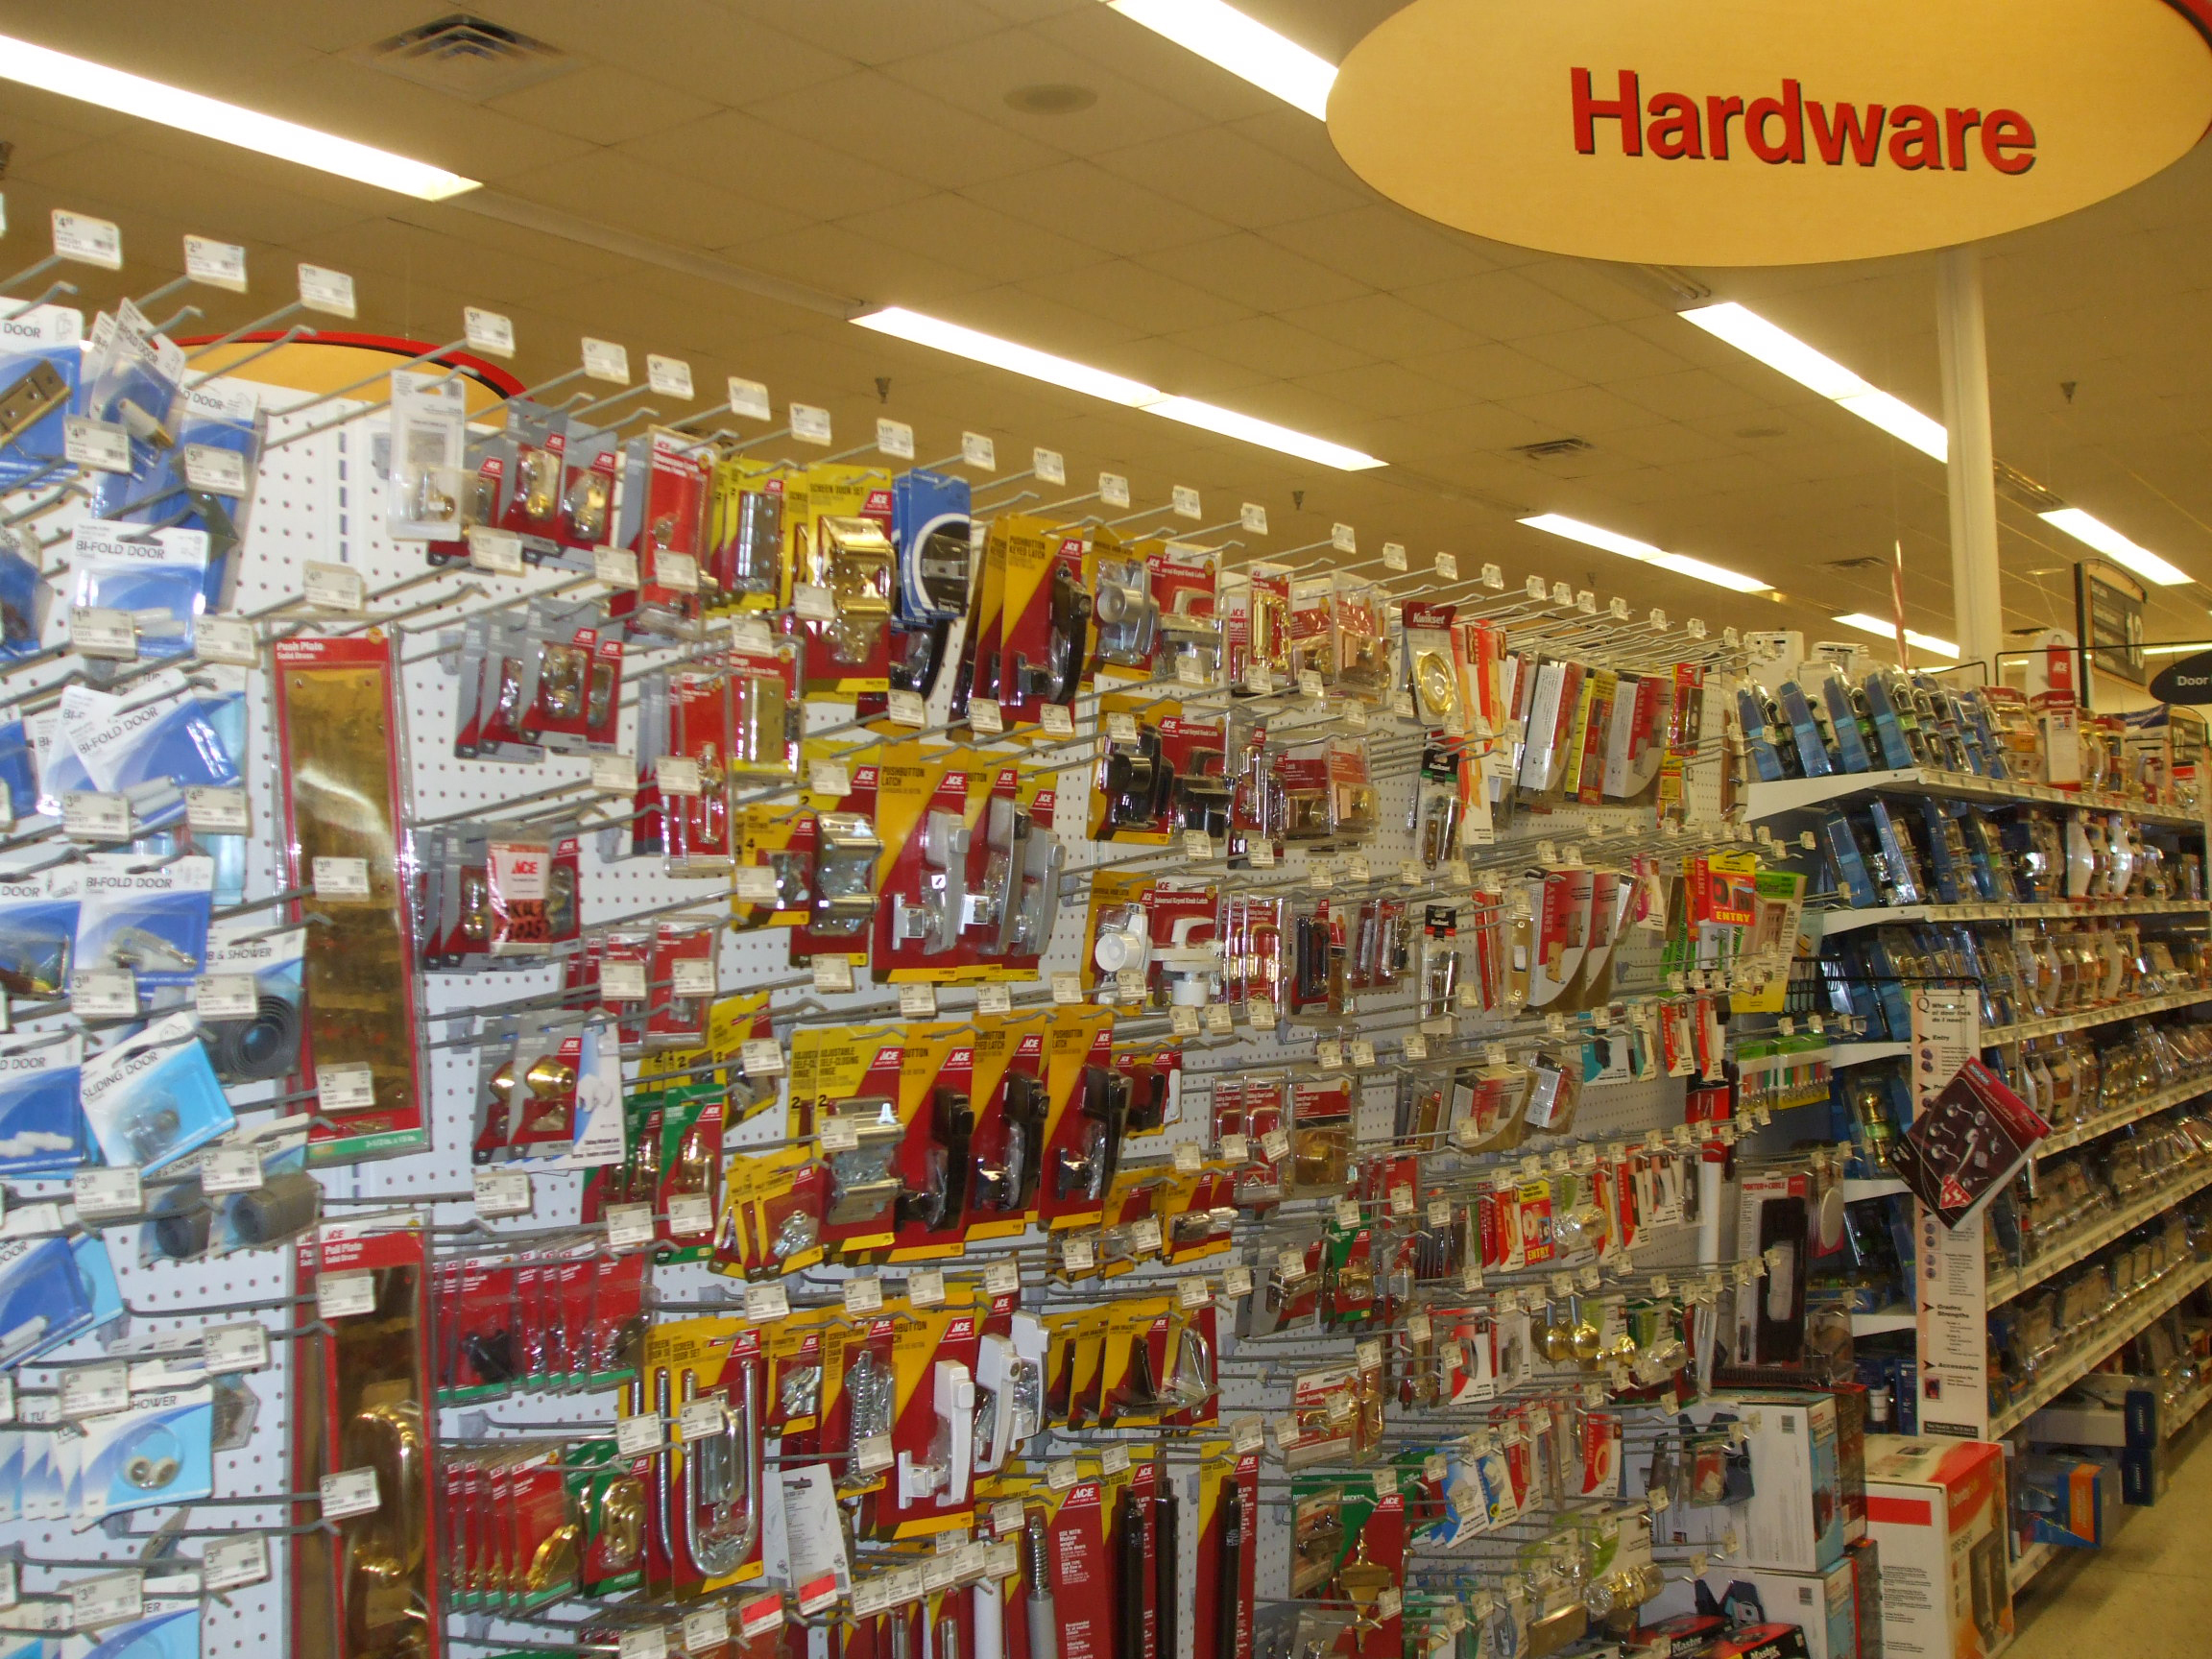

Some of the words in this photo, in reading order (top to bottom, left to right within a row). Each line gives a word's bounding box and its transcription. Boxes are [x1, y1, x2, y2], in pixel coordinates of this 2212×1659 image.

[1570, 67, 2036, 176] Hardware
[3, 323, 41, 340] DOOR
[193, 393, 224, 410] DOOR
[867, 493, 889, 505] ACE
[1009, 535, 1046, 550] PUSHBUTTON
[1062, 541, 1079, 552] ACE
[76, 540, 124, 556] BI-FOLD
[128, 544, 165, 560] DOOR
[1148, 559, 1163, 568] ACE
[1231, 609, 1245, 617] ACE
[1412, 613, 1446, 625] Kwikset
[2053, 661, 2068, 672] ACE
[2177, 675, 2208, 686] Door
[79, 725, 123, 755] BI-FOLD
[125, 707, 158, 732] DOOR
[1161, 720, 1177, 730] ACE
[859, 770, 878, 781] ACE
[881, 765, 925, 779] PUSHBUTTON
[1001, 771, 1014, 782] ACE
[880, 777, 902, 787] LATCH
[946, 774, 964, 785] ACE
[1037, 792, 1052, 804] ACE
[800, 821, 813, 830] ACE
[511, 861, 539, 875] ACE
[86, 877, 132, 890] BI-FOLD
[136, 877, 173, 890] DOOR
[1156, 881, 1170, 891] ACE
[2, 885, 40, 899] DOOR
[1142, 892, 1154, 902] ACE
[1543, 884, 1555, 935] ENTRY
[1716, 910, 1751, 924] ENTRY
[226, 948, 272, 961] SHOWER
[1916, 997, 1930, 1014] Q
[1052, 1028, 1083, 1039] PUSHBUTTON
[1097, 1033, 1110, 1043] ACE
[1022, 1039, 1040, 1049] ACE
[1052, 1039, 1068, 1050] LATCH
[820, 1046, 855, 1058] ADJUSTABLE
[879, 1050, 900, 1062] ACE
[949, 1050, 971, 1062] ACE
[12, 1056, 46, 1070] DOOR
[677, 1056, 686, 1067] 2
[82, 1069, 124, 1099] SLIDING
[125, 1051, 158, 1076] DOOR
[819, 1067, 836, 1076] HINGE
[791, 1096, 801, 1110] 2
[818, 1094, 829, 1108] 2
[1527, 1246, 1551, 1262] ENTRY
[994, 1298, 1006, 1309] ACE
[1936, 1310, 1970, 1319] Strengths
[876, 1320, 891, 1330] ACE
[951, 1320, 972, 1334] ACE
[1297, 1382, 1311, 1391] ACE
[1240, 1456, 1256, 1467] ACE
[1138, 1468, 1153, 1479] ACE
[1073, 1487, 1094, 1500] ACE
[1382, 1496, 1400, 1505] ACE
[1059, 1529, 1068, 1538] USE
[1068, 1527, 1083, 1537] WITH:
[1671, 1636, 1703, 1653] Master
